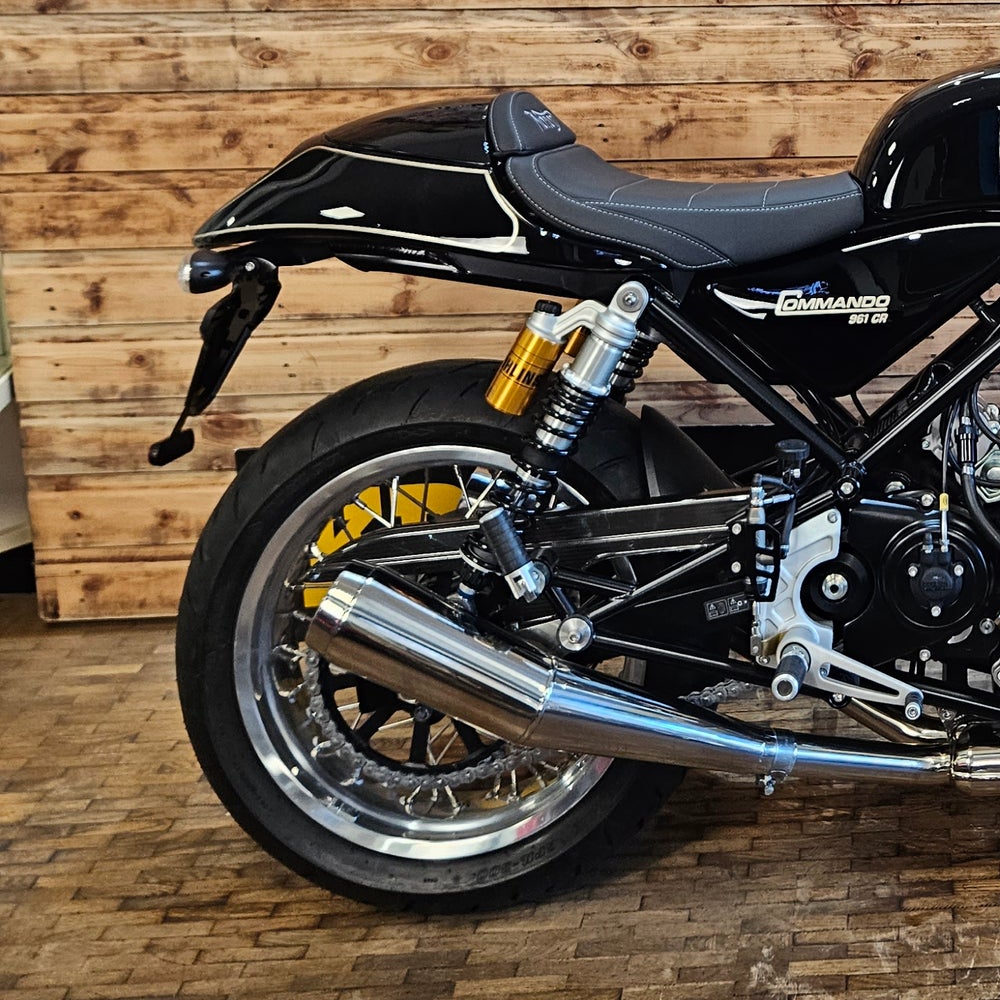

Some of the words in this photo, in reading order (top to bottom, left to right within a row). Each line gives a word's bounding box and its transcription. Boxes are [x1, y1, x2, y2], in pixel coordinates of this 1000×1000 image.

[774, 289, 891, 317] COMMANDO
[848, 313, 868, 325] 961
[870, 313, 889, 325] CR
